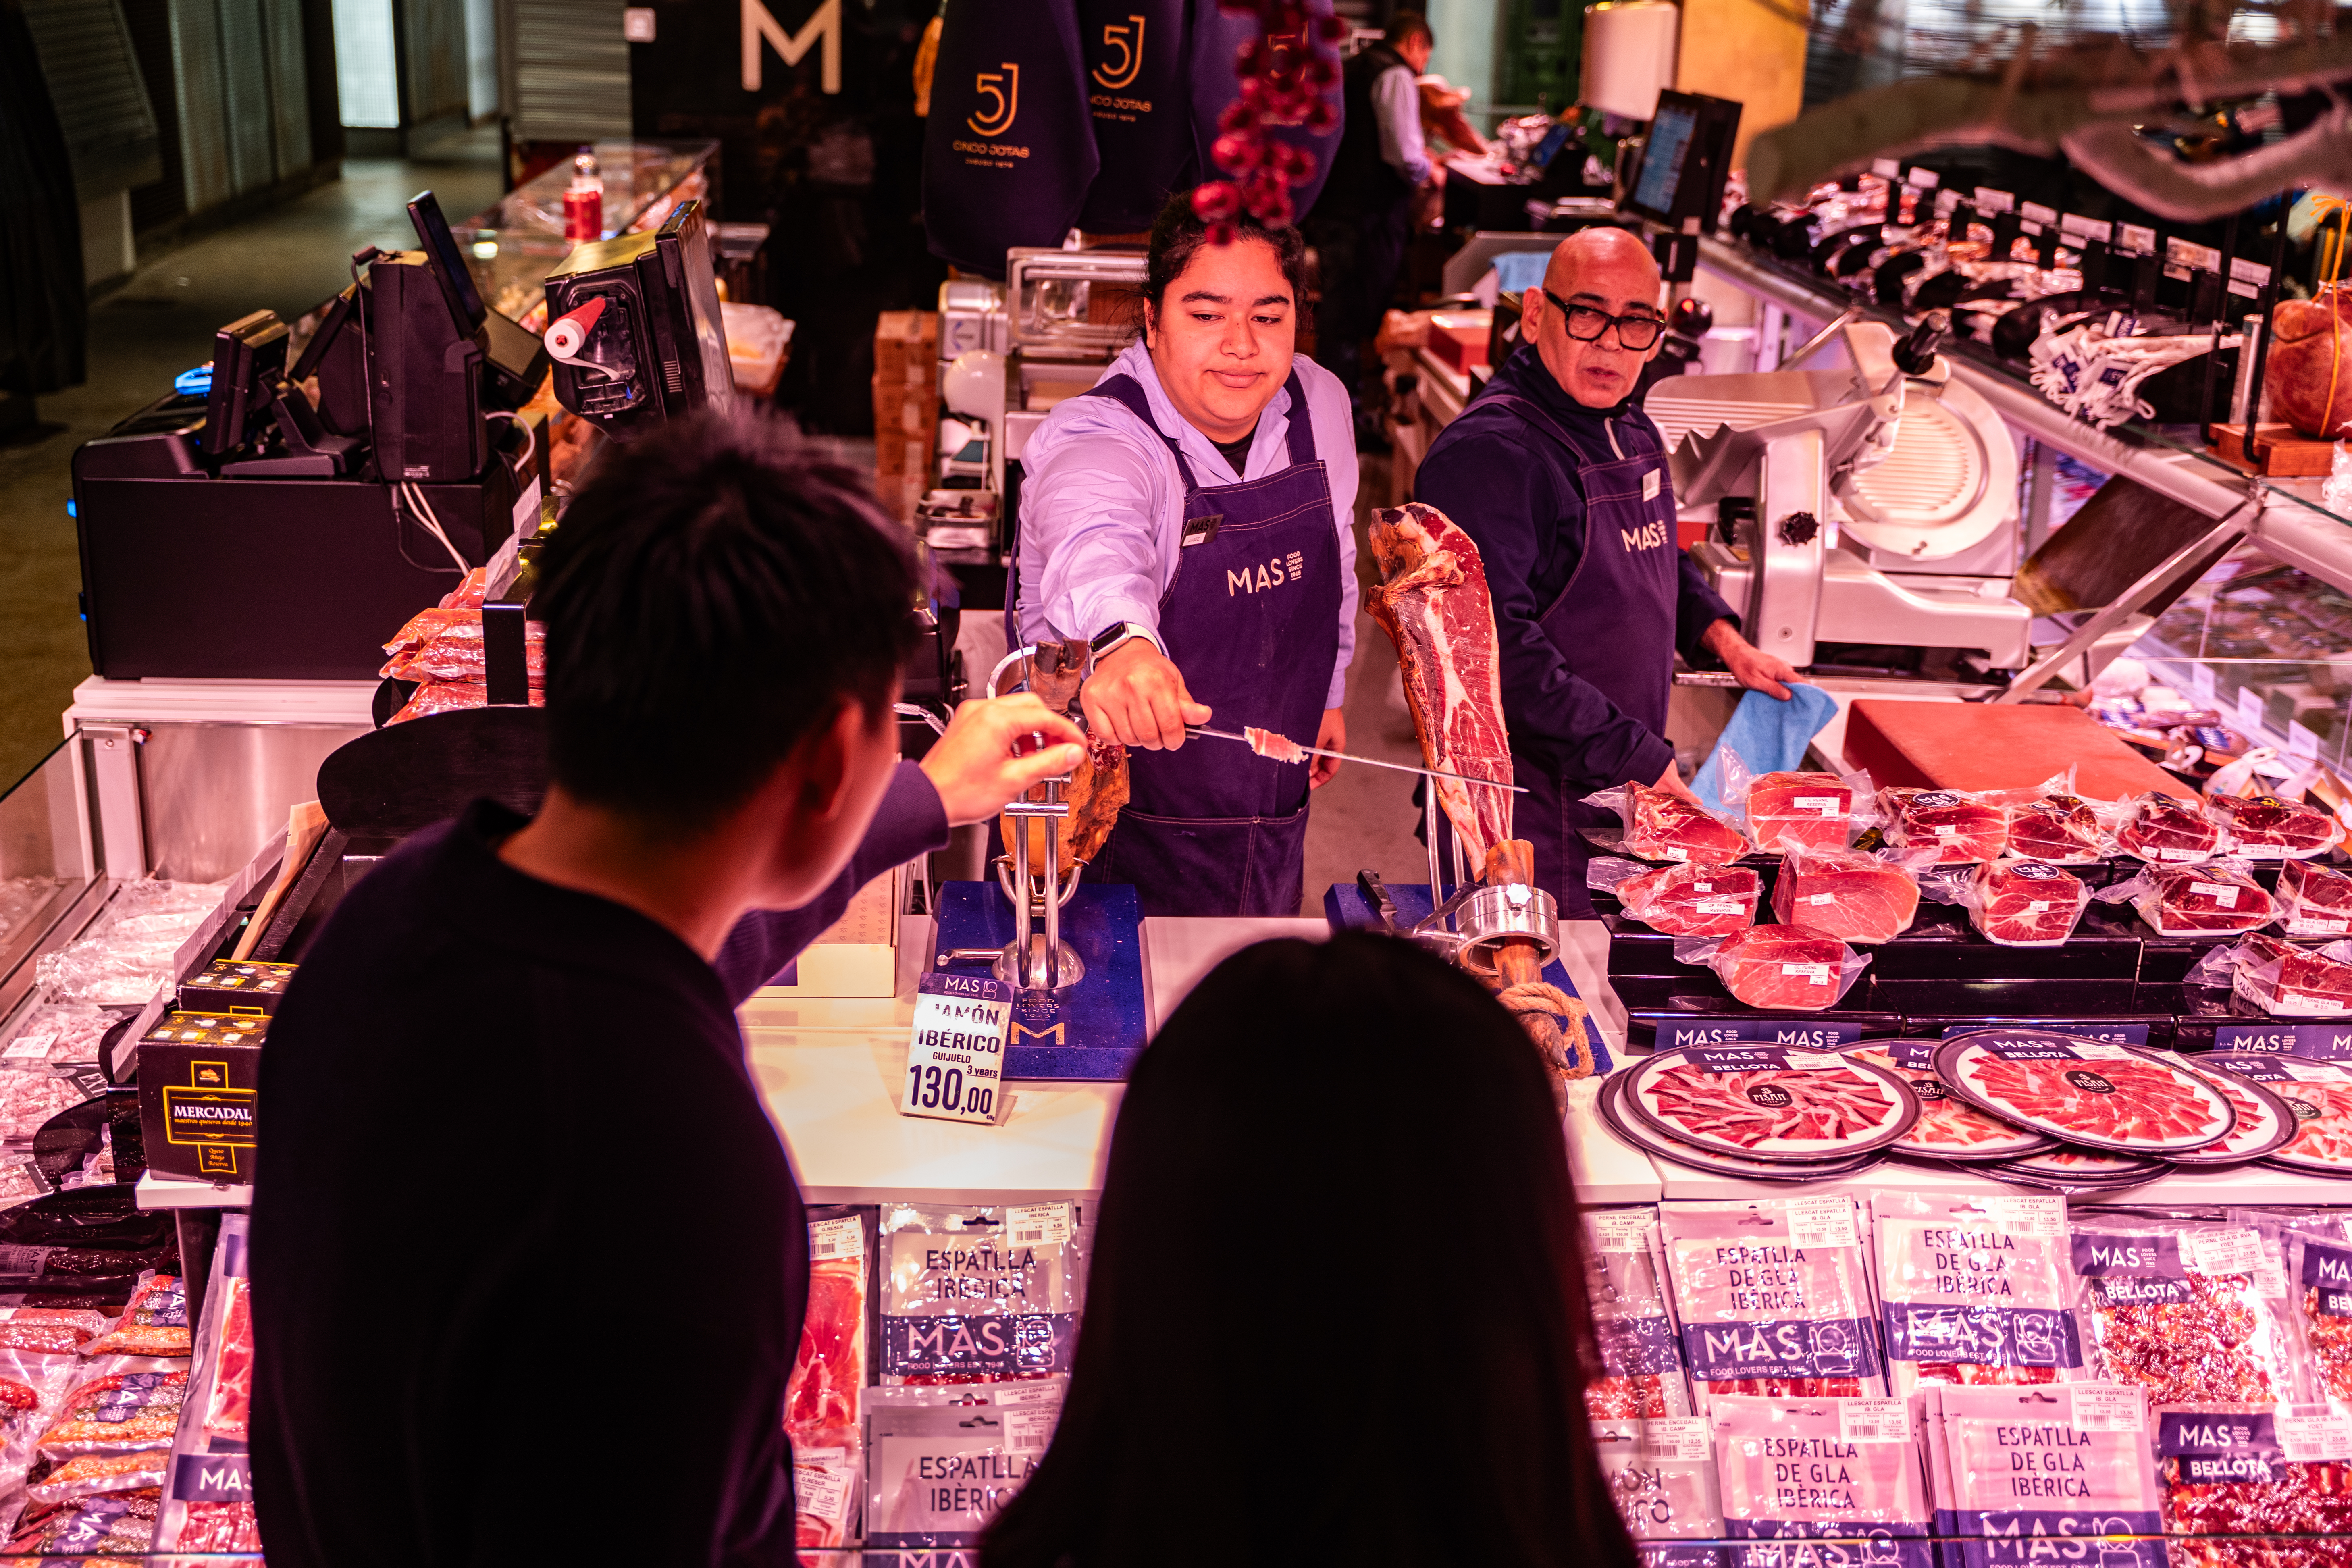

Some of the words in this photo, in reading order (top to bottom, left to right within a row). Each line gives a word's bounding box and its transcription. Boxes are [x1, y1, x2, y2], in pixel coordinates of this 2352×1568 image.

[741, 0, 841, 94] M
[1113, 97, 1152, 112] JOTAS
[953, 140, 987, 154] CINCO
[989, 144, 1030, 158] JOTAS
[1621, 523, 1661, 552] MAS
[1286, 556, 1303, 567] LOVERS
[1287, 551, 1300, 560] FOOD
[1227, 558, 1284, 597] MAS
[1288, 564, 1302, 572] SINCE
[1291, 570, 1301, 578] 1945
[945, 977, 979, 992] MAS
[918, 1028, 1000, 1053] IBÉRICO
[1011, 1021, 1065, 1045] M
[1777, 1030, 1824, 1048] MAS
[2233, 1035, 2279, 1051] MAS
[933, 1052, 971, 1064] GUIJUELO
[1703, 1052, 1755, 1061] MAS
[2224, 1061, 2252, 1070] AS
[967, 1065, 973, 1075] 3
[975, 1067, 998, 1077] years
[910, 1064, 992, 1115] 130,00
[174, 1106, 252, 1120] MERCADAL
[927, 1249, 1036, 1270] ESPATLLA
[1716, 1246, 1806, 1265] ESPATLLA
[1936, 1253, 1959, 1270] DE
[2091, 1246, 2140, 1267] MAS
[938, 1273, 1026, 1298] IBÈRICA
[1730, 1269, 1754, 1287] DE
[1763, 1268, 1799, 1286] GLA
[1936, 1271, 2011, 1295] IBÈRICA
[1731, 1289, 1806, 1309] IBÈRICA
[2105, 1284, 2179, 1299] BELLOTA
[1907, 1310, 2005, 1347] MAS
[908, 1321, 1004, 1358] MAS
[1704, 1326, 1802, 1363] MAS
[1710, 1368, 1733, 1376] FOOD
[1734, 1366, 1768, 1375] LOVERS
[1997, 1427, 2091, 1446] ESPATLLA
[2179, 1425, 2231, 1447] MAS
[1764, 1438, 1858, 1458] ESPATLLA
[2011, 1452, 2036, 1471] DE
[2043, 1452, 2085, 1471] GLA
[2190, 1460, 2272, 1477] BELLOTA
[802, 1477, 825, 1486] G.RESER
[1776, 1464, 1801, 1482] DE
[1810, 1464, 1850, 1483] GLA
[2012, 1472, 2090, 1497] IBÈRICA
[1777, 1484, 1855, 1508] IBÈRICA
[1747, 1527, 1849, 1568] MAS
[1983, 1517, 2087, 1559] MAS
